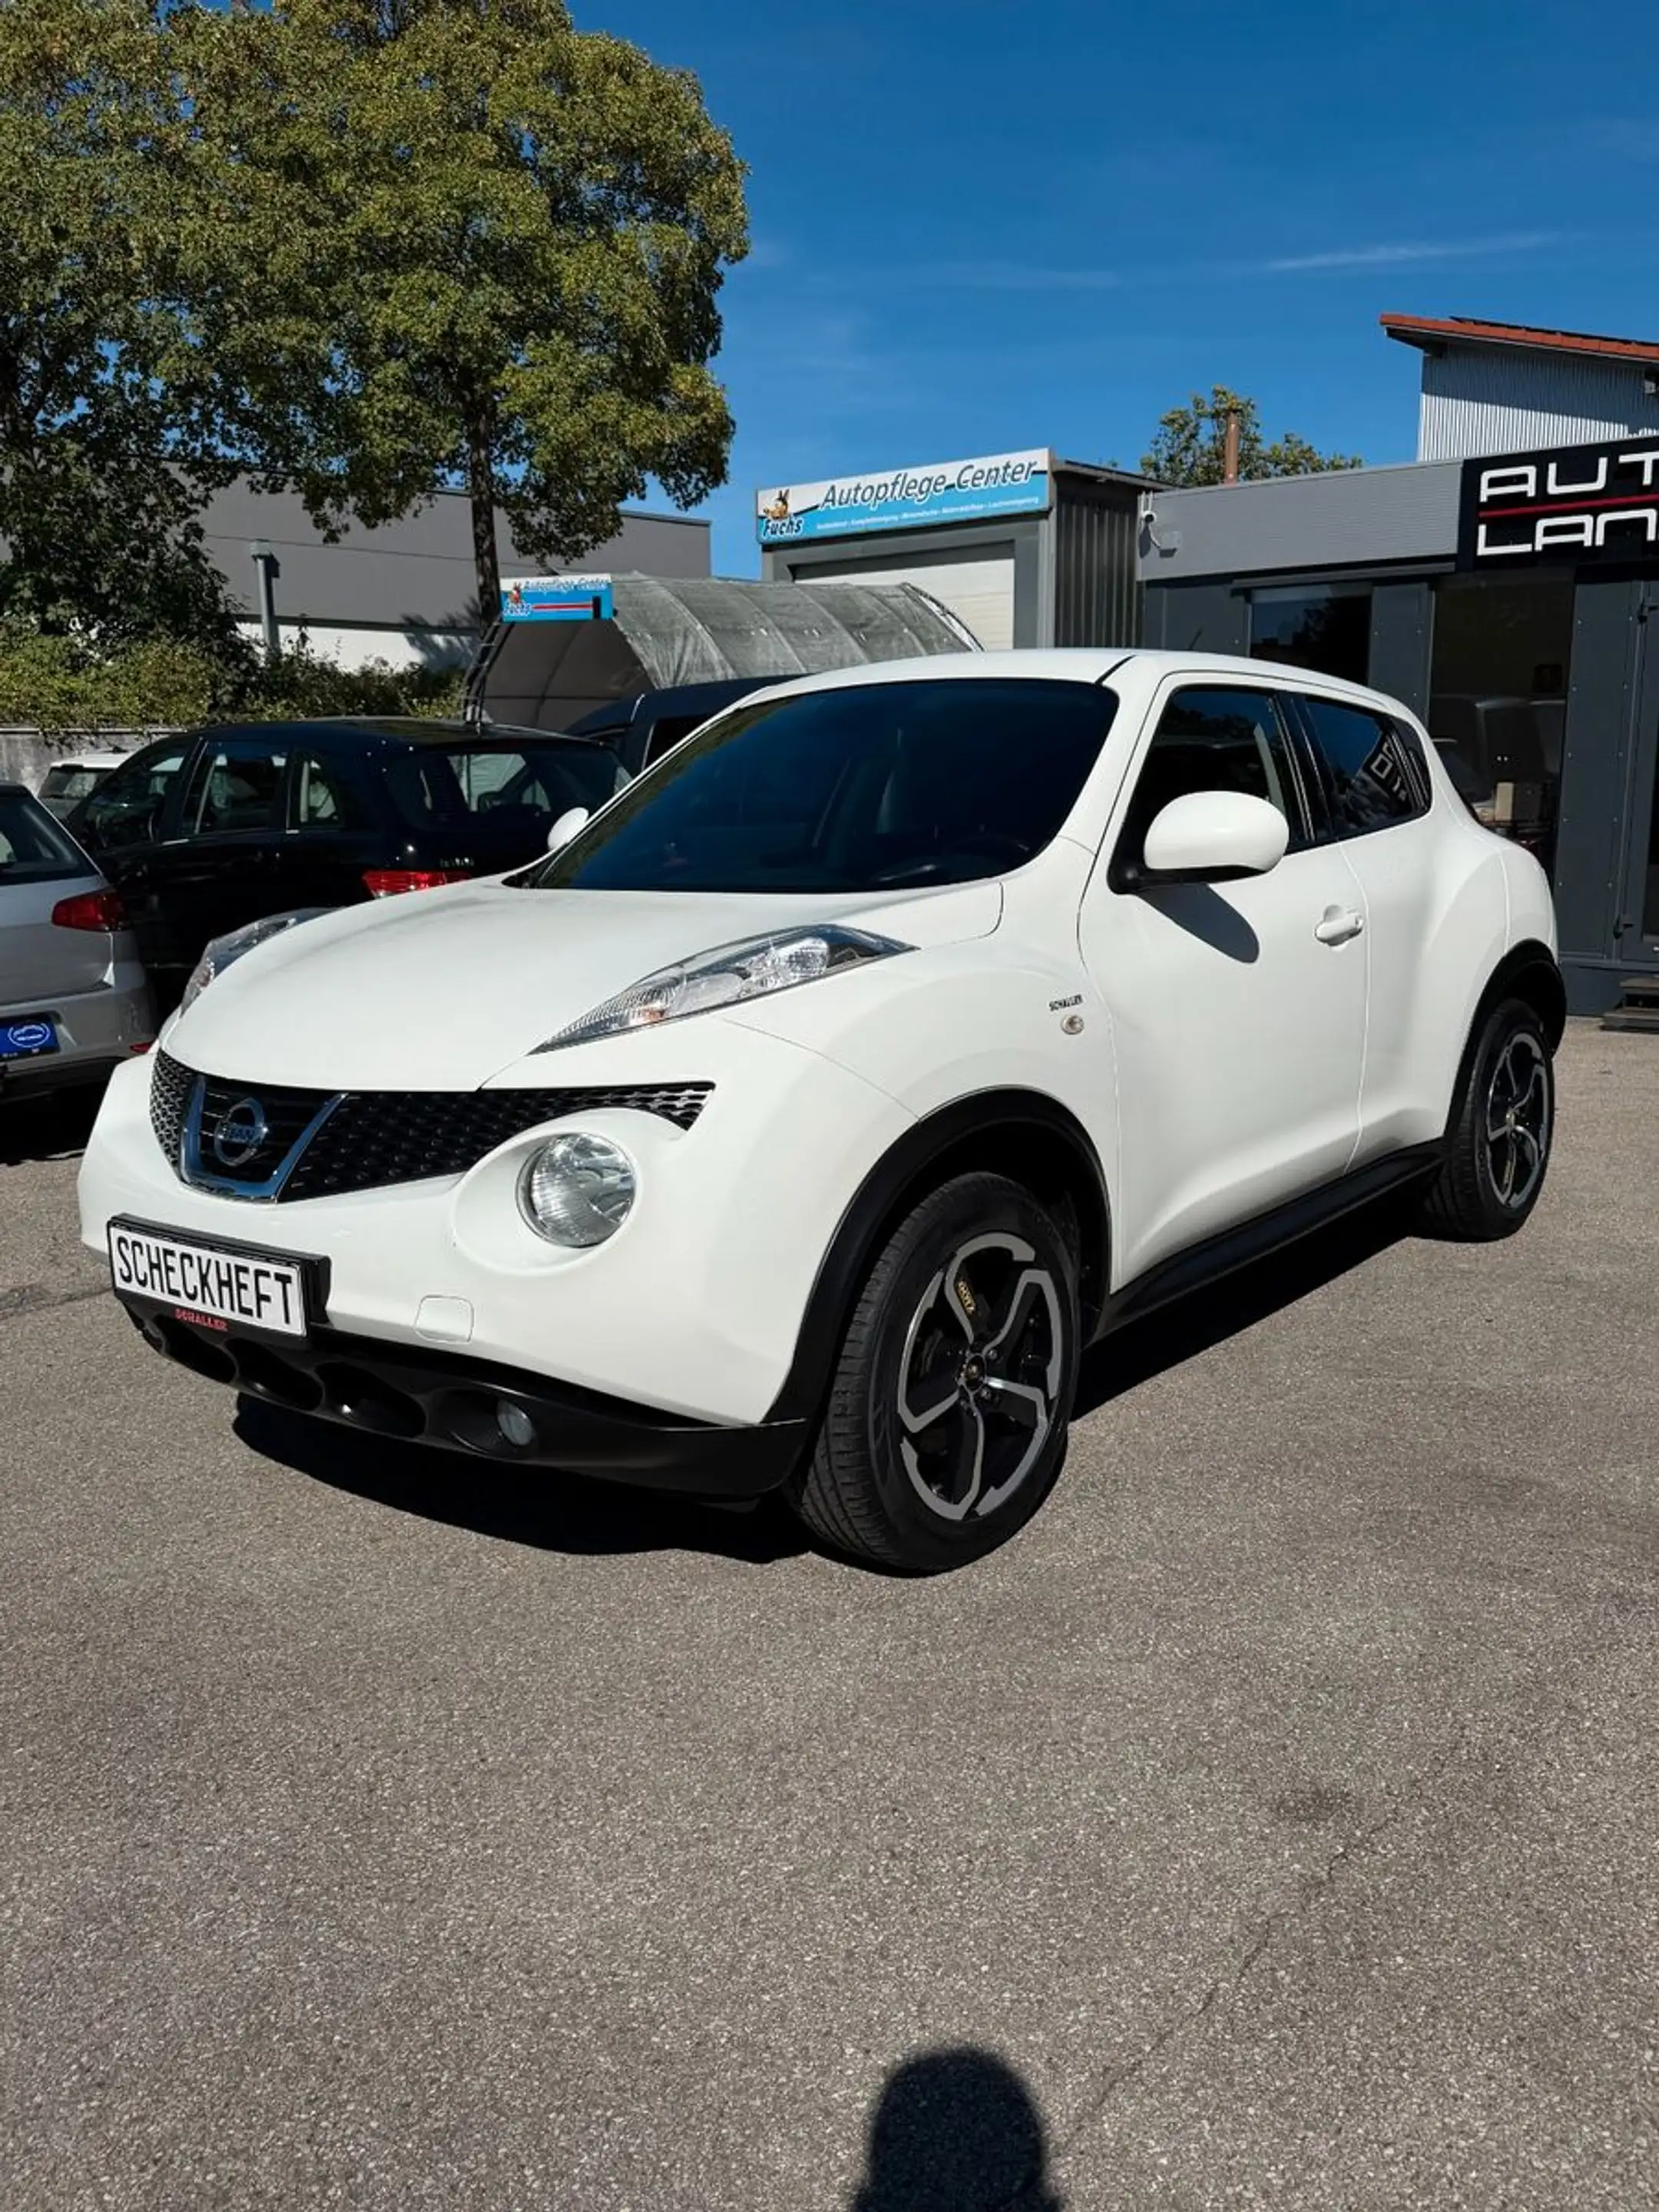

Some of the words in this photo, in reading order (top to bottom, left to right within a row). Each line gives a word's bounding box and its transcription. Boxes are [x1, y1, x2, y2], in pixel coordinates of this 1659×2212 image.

[821, 472, 947, 508] Autopflege
[956, 459, 1037, 490] Center
[763, 516, 803, 537] Fuchs
[117, 1236, 293, 1325] SCHECKHEFT
